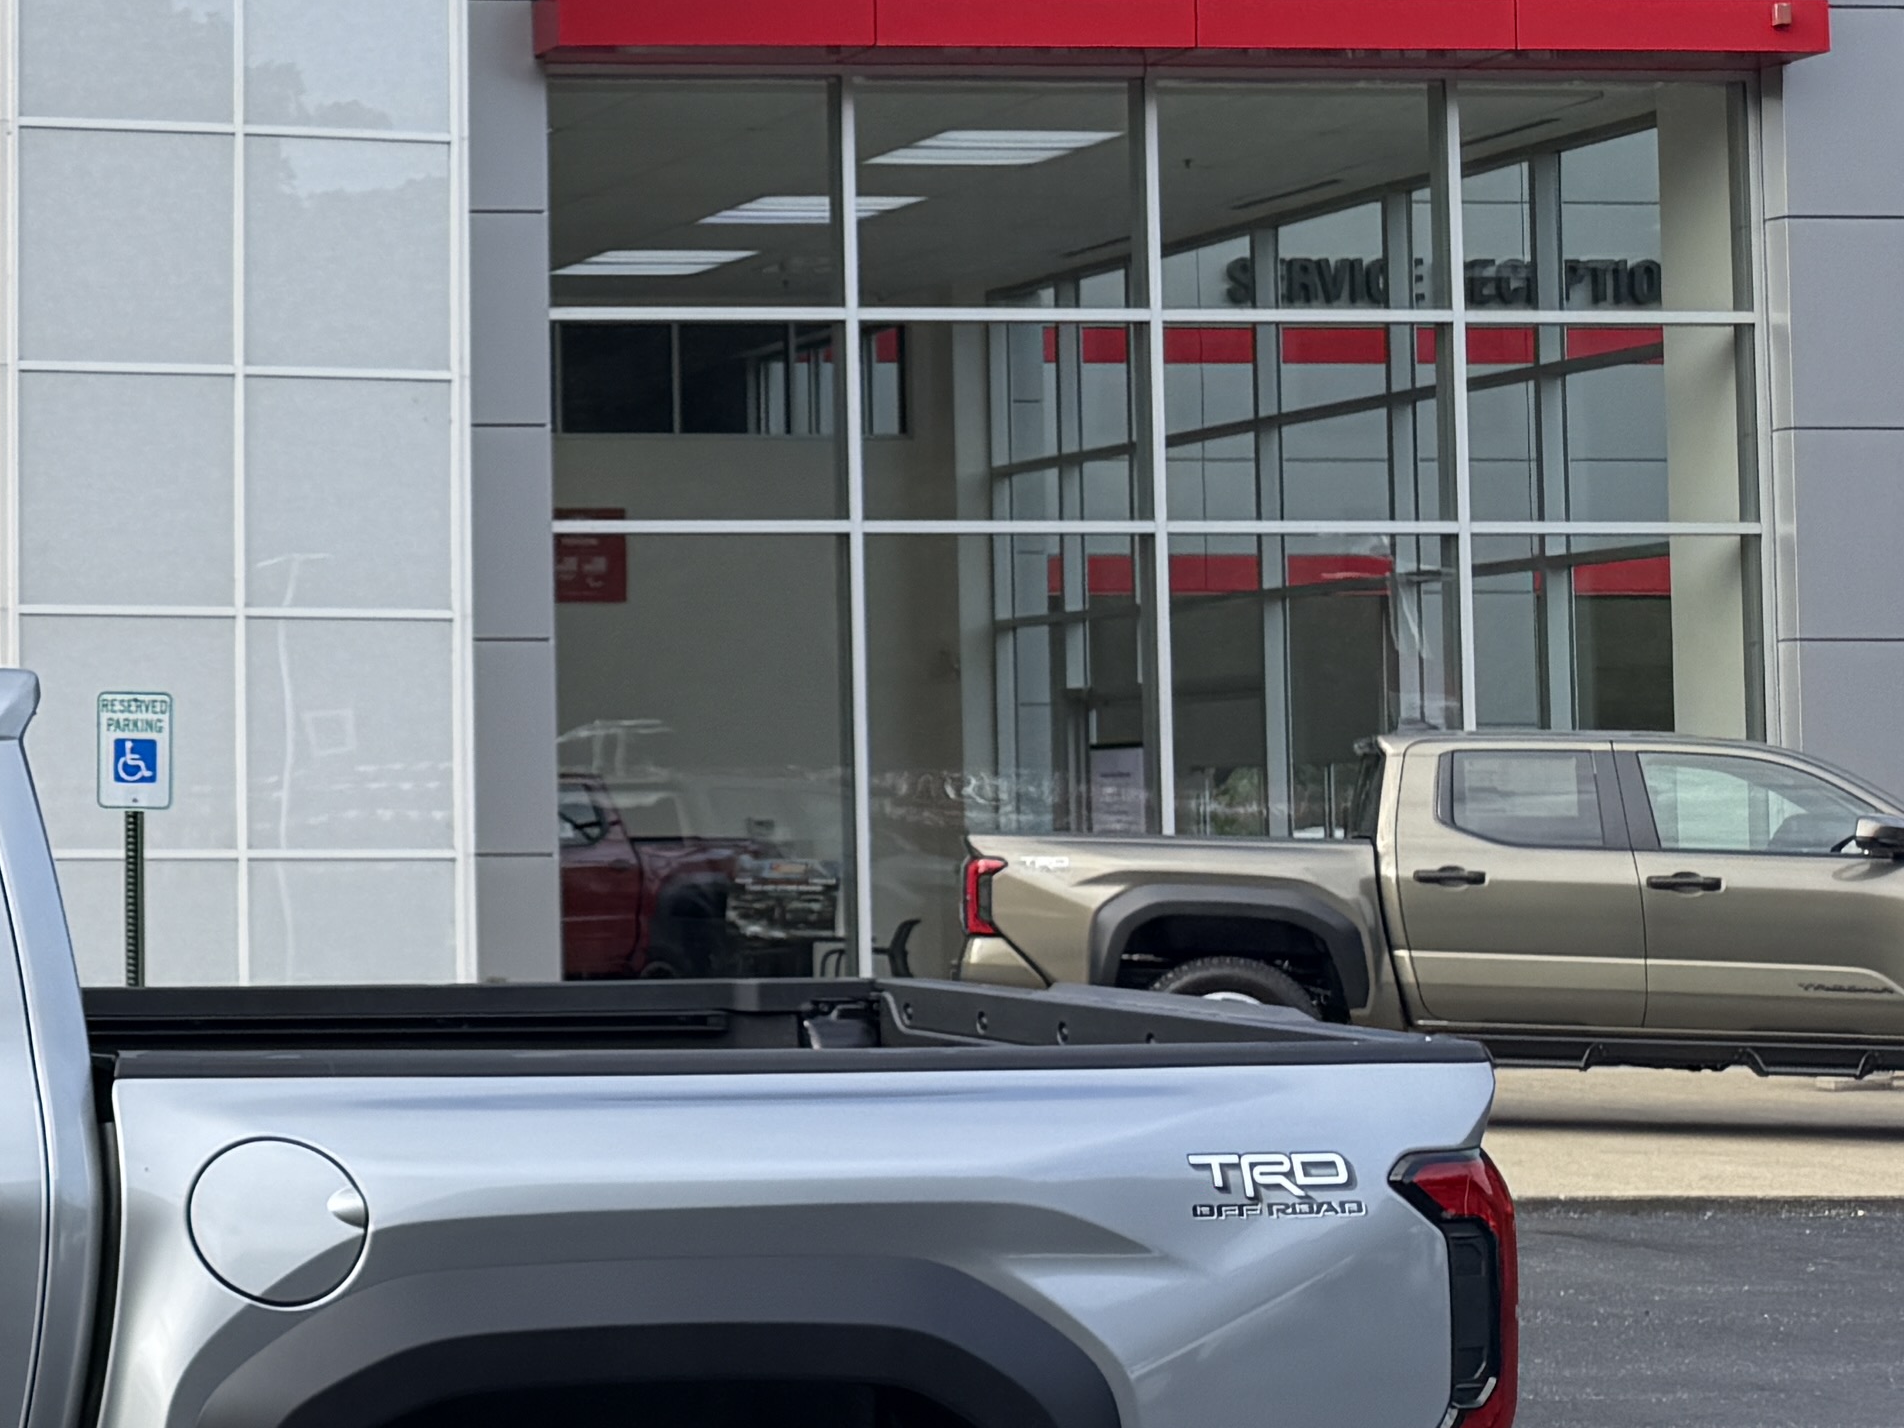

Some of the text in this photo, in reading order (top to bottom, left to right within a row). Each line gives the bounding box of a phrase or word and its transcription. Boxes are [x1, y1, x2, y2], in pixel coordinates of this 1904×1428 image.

[100, 698, 168, 714] RESERVED
[106, 717, 164, 733] PARKING
[1020, 856, 1069, 870] TRD
[1187, 1152, 1352, 1199] TRD
[1193, 1200, 1368, 1220] OFF ROAD
